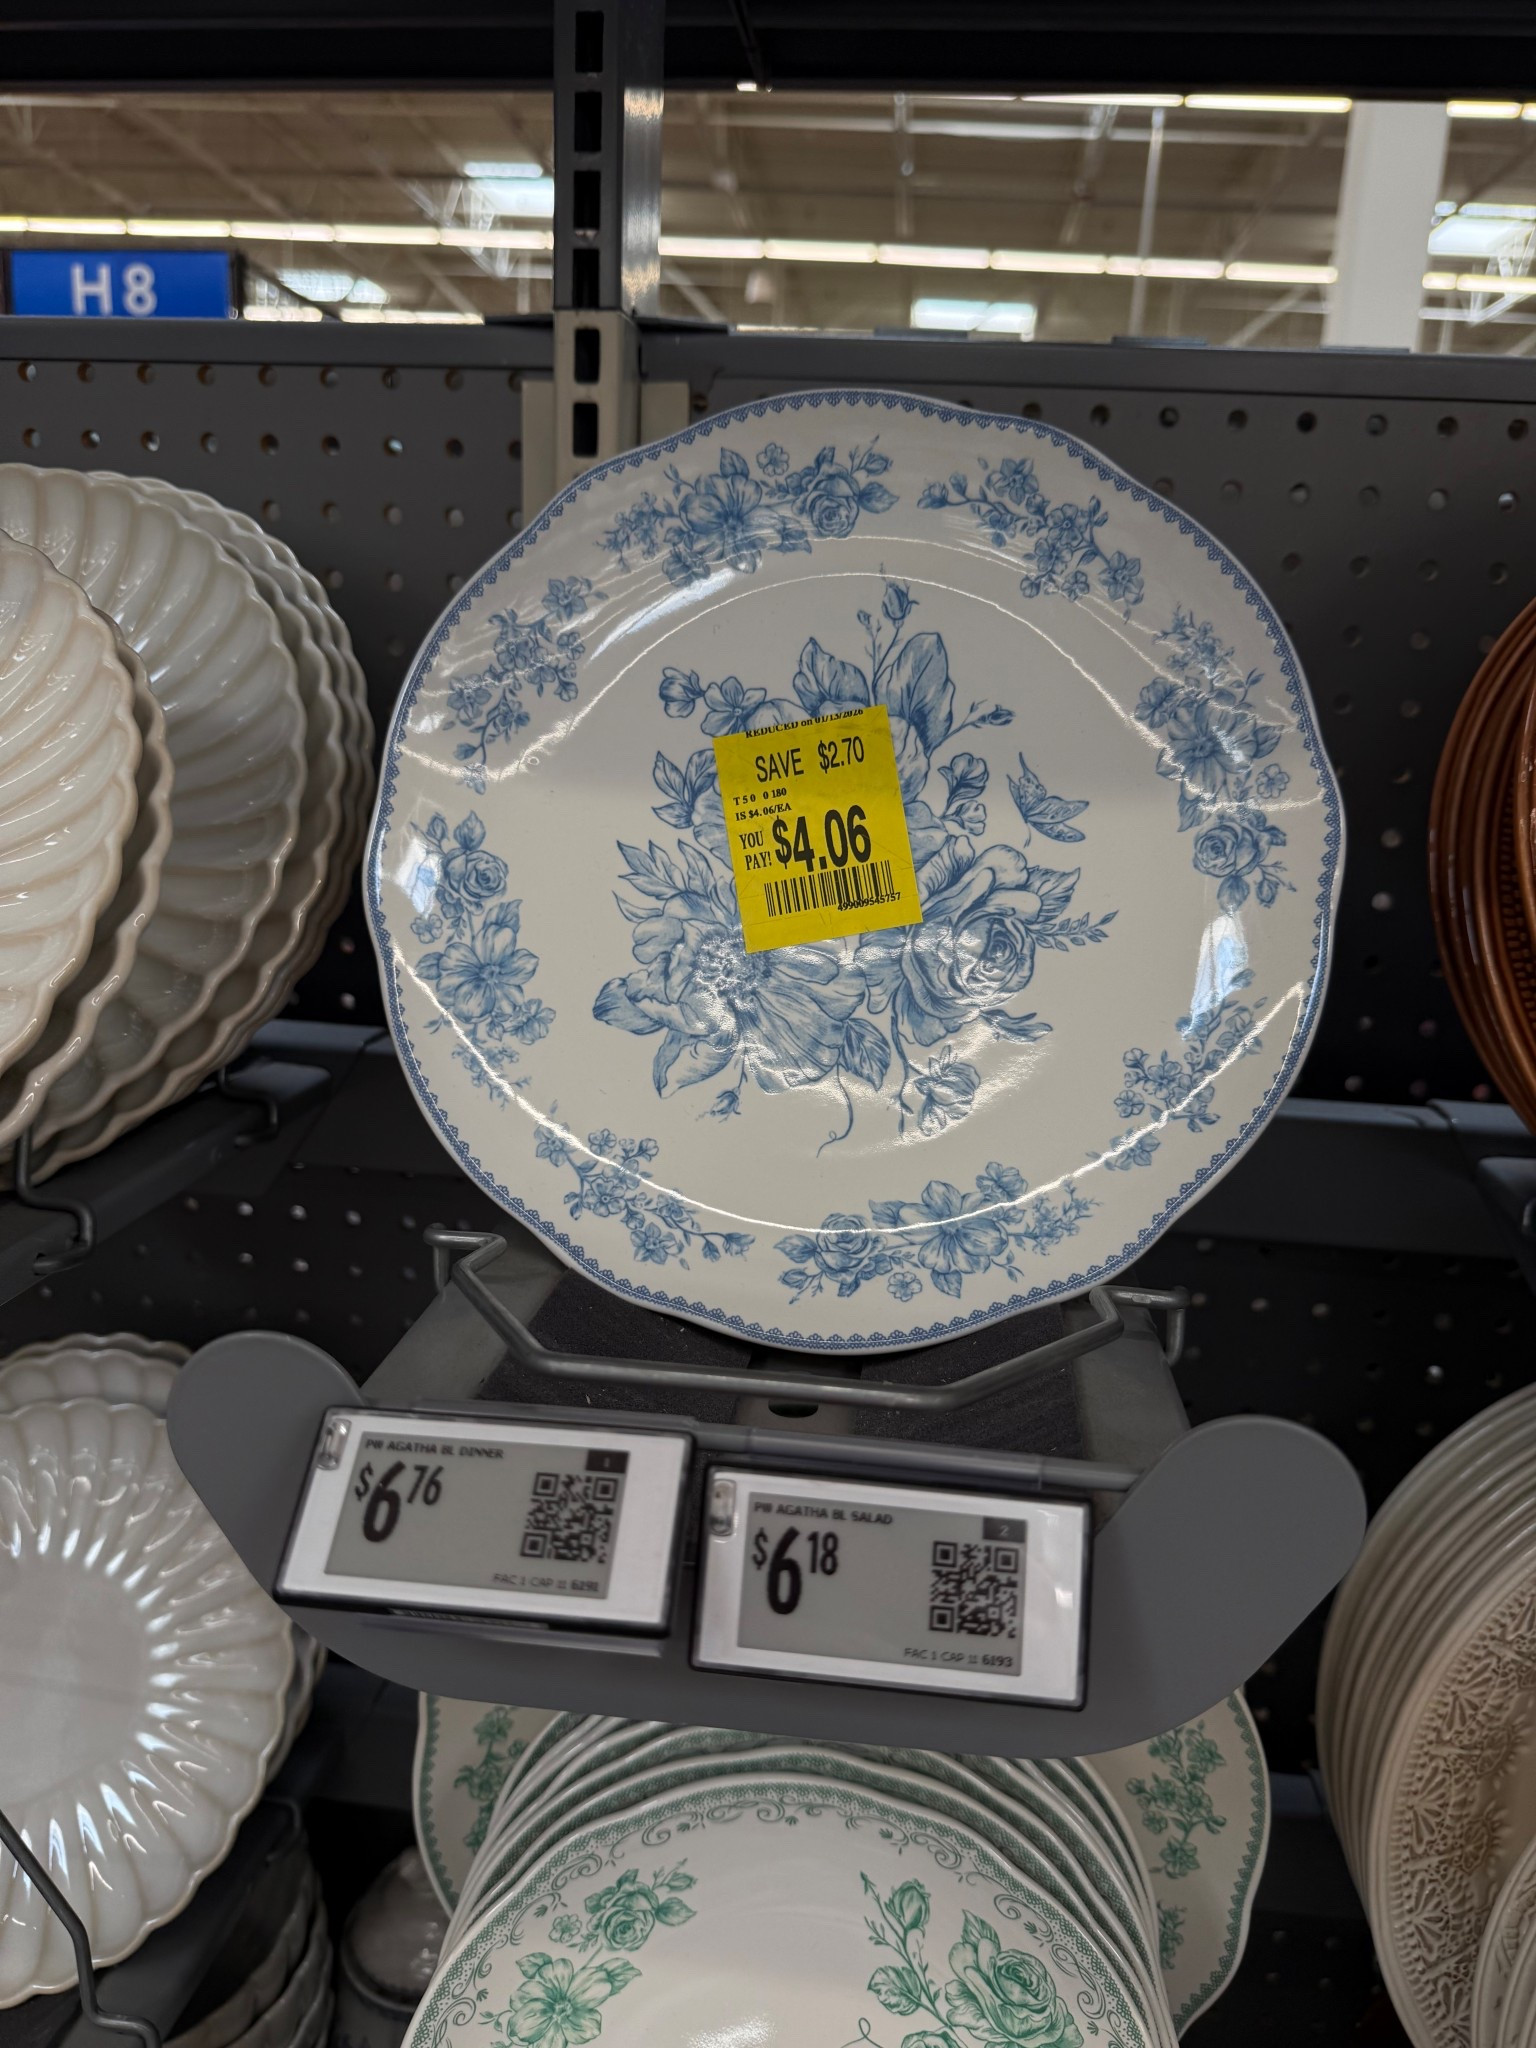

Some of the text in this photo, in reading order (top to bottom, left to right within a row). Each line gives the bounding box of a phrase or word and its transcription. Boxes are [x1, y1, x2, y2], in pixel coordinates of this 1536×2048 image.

[745, 722, 799, 739] REDUCED
[801, 718, 813, 727] on
[755, 736, 865, 783] SAVE $2.70
[735, 802, 792, 821] IS $4.06/EA
[739, 830, 764, 849] YOU
[772, 805, 871, 872] $4.06
[745, 851, 772, 870] PAY!
[387, 1440, 437, 1454] AGATHA
[440, 1444, 454, 1455] BL
[458, 1446, 504, 1459] DINNER
[776, 1503, 829, 1519] AGATHA
[832, 1508, 846, 1520] BL
[850, 1510, 893, 1525] SALAD
[1000, 1525, 1009, 1536] 2
[528, 1576, 554, 1588] CAP
[903, 1648, 928, 1659] FAC
[940, 1651, 965, 1662] CAP
[982, 1654, 1014, 1667] 6193
